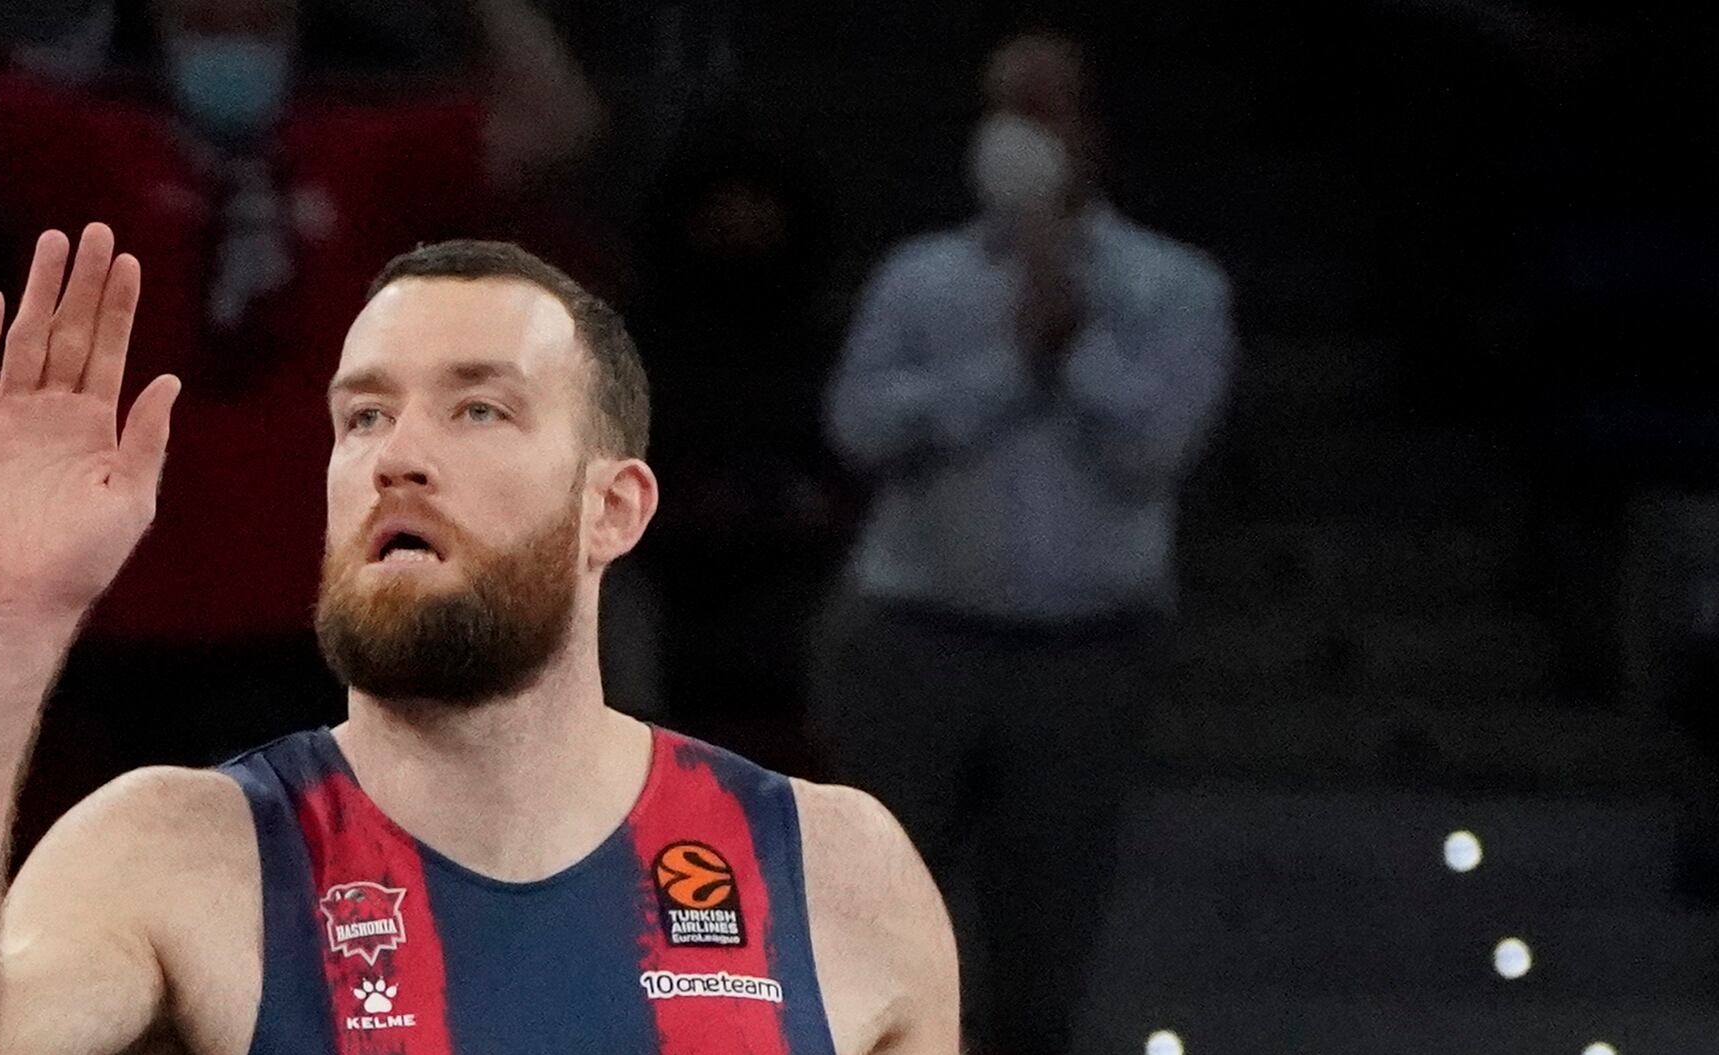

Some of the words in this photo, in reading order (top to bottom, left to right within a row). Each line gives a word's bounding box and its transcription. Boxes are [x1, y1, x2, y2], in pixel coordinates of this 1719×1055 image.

[668, 910, 737, 922] TURKISH
[671, 922, 739, 934] AIRLINES
[346, 1014, 416, 1030] KELME
